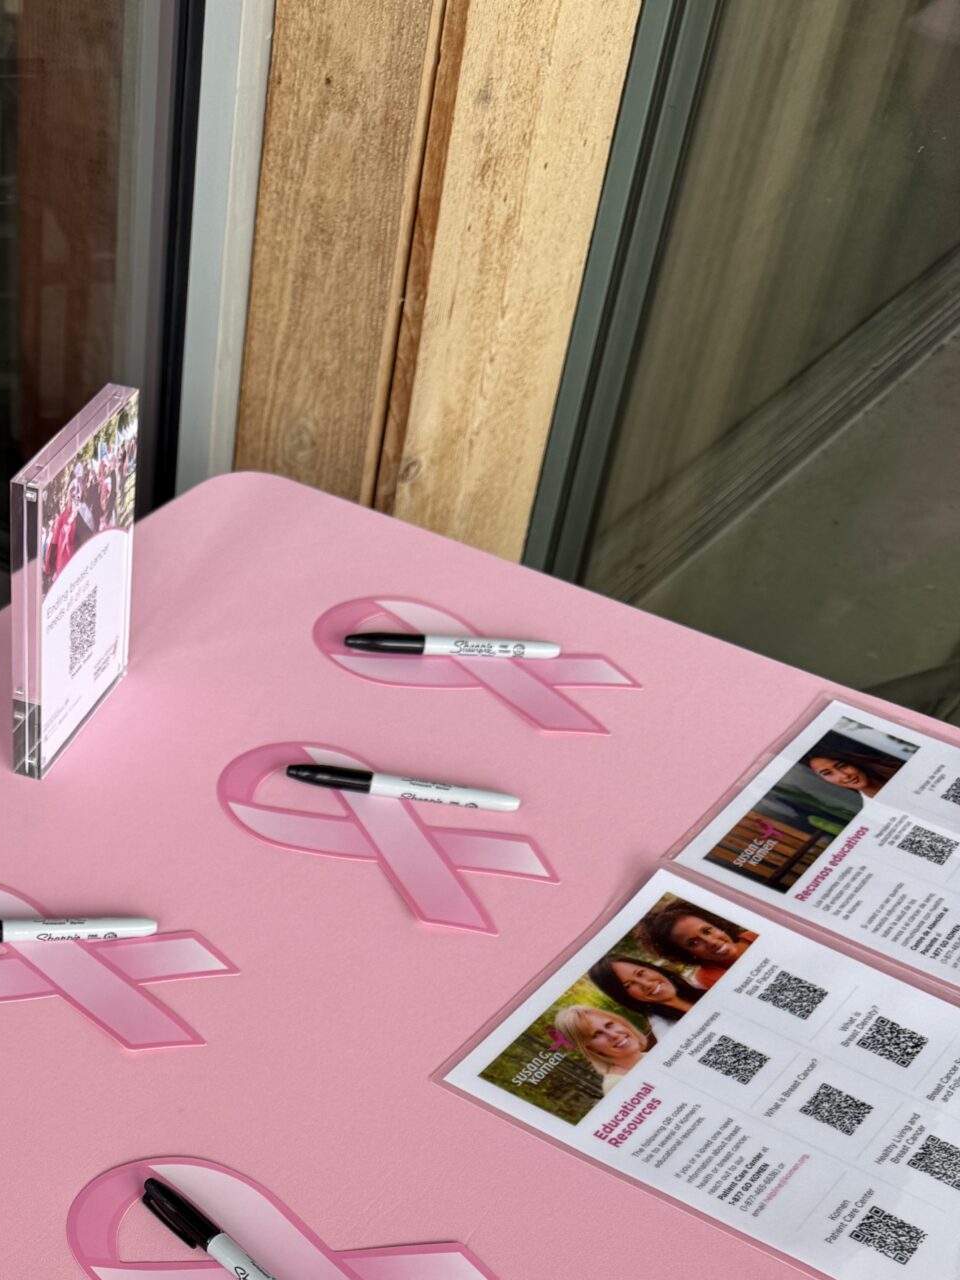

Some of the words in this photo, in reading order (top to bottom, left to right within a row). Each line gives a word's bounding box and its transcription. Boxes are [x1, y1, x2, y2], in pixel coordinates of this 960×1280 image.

[793, 865, 834, 902] Recursos
[825, 824, 870, 866] educativos
[733, 975, 754, 993] Breast
[749, 957, 771, 976] Cancer
[838, 1016, 857, 1032] What
[839, 1028, 860, 1047] Breast
[662, 1048, 684, 1067] Breast
[762, 1101, 782, 1118] What
[781, 1078, 802, 1097] Breast
[796, 1057, 820, 1080] Cancer?
[592, 1081, 655, 1141] Educational
[607, 1095, 662, 1148] Resources
[631, 1146, 645, 1157] The
[640, 1124, 667, 1148] following
[661, 1116, 674, 1126] QR
[669, 1101, 688, 1117] codes
[642, 1152, 655, 1163] link
[657, 1129, 677, 1147] several
[652, 1138, 683, 1168] educational
[679, 1163, 693, 1174] you
[697, 1139, 713, 1154] loved
[710, 1130, 722, 1141] one
[718, 1117, 734, 1131] need
[685, 1154, 714, 1184] information
[710, 1140, 728, 1156] about
[724, 1124, 742, 1142] breast
[873, 1141, 898, 1165] Healthy
[891, 1124, 913, 1143] Living
[906, 1112, 921, 1125] and
[889, 1143, 911, 1164] Breast
[904, 1124, 927, 1145] Cancer
[696, 1172, 714, 1189] health
[716, 1150, 734, 1168] breast
[706, 1179, 724, 1195] reach
[720, 1170, 732, 1181] out
[734, 1155, 745, 1165] our
[716, 1180, 738, 1200] Patient
[733, 1168, 749, 1182] Care
[744, 1151, 764, 1170] Center
[727, 1190, 744, 1206] 1-877
[740, 1181, 753, 1192] GO
[748, 1162, 770, 1182] KOMEN
[750, 1201, 767, 1217] email
[824, 1221, 847, 1244] Patient
[841, 1206, 860, 1223] Care
[854, 1186, 876, 1208] Center
[827, 1198, 851, 1221] Komen
